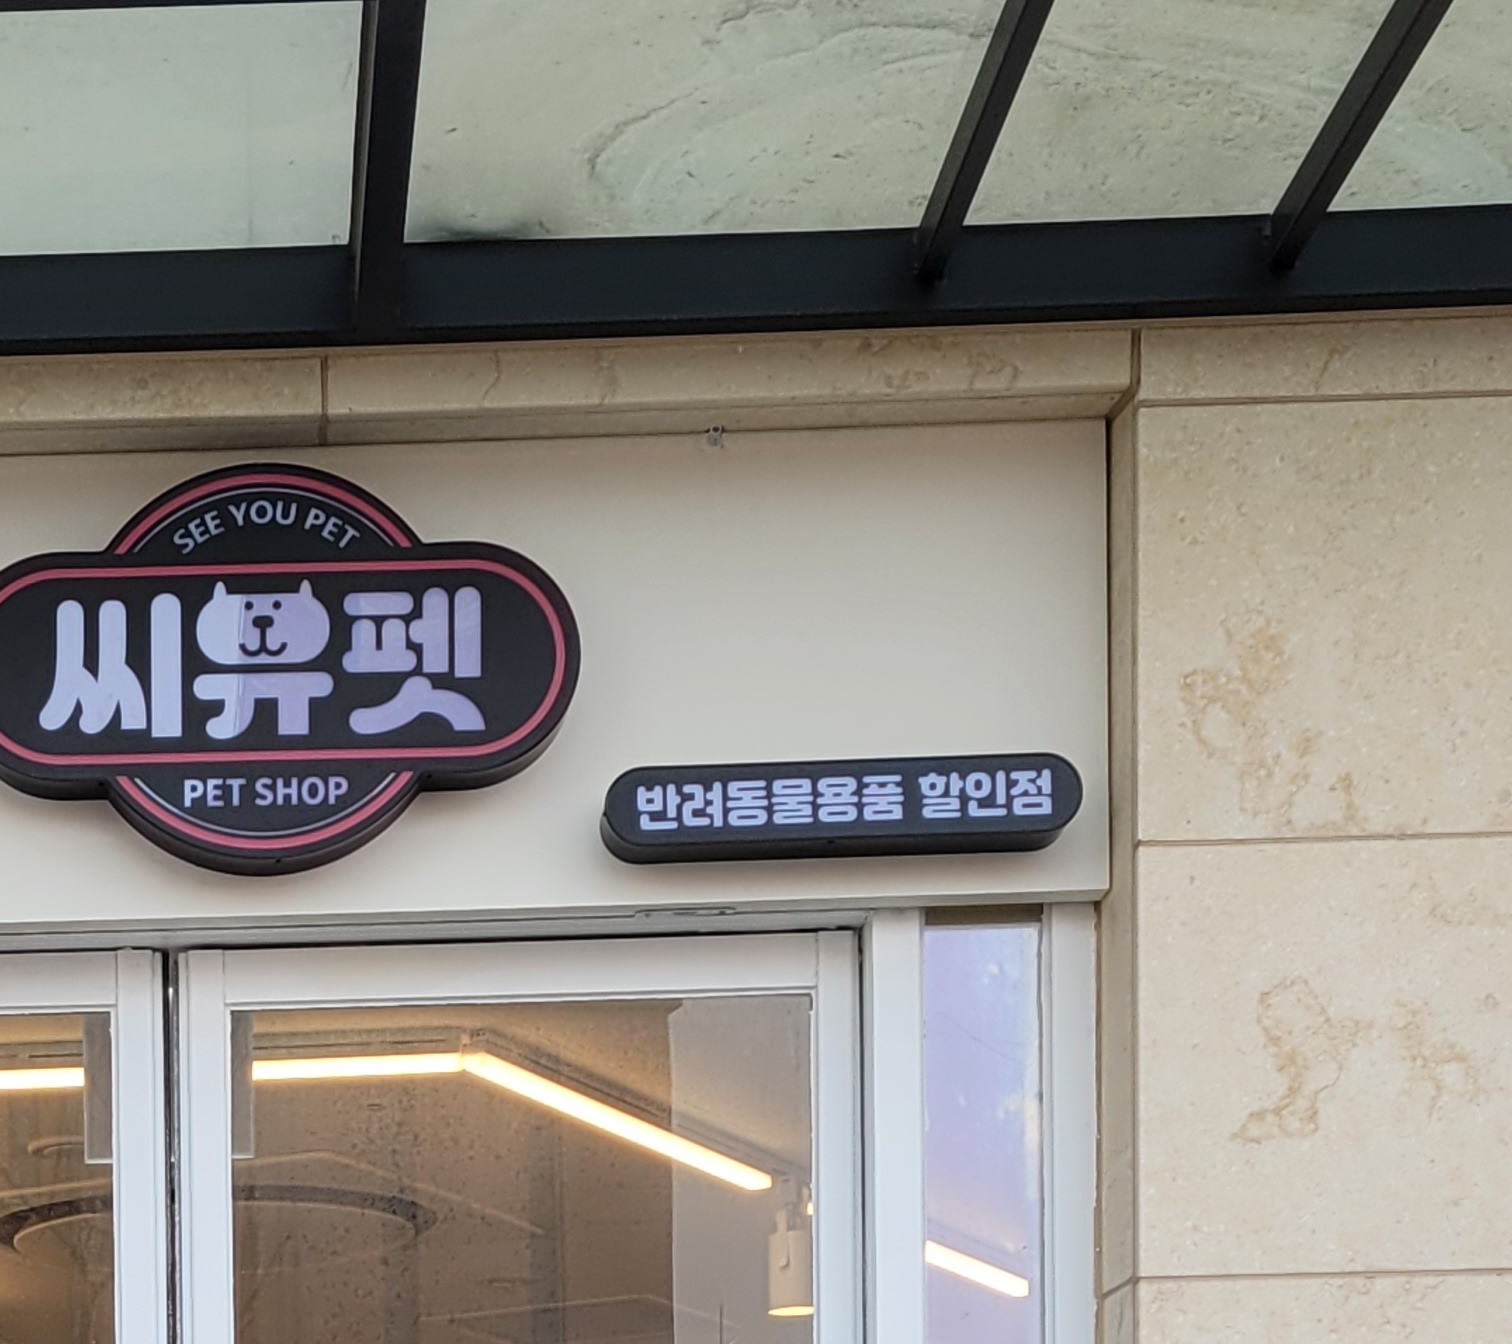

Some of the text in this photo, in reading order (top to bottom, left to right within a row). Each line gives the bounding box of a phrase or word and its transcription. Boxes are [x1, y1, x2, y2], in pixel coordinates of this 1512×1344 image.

[173, 500, 361, 554] SEE YOU PET
[39, 580, 485, 739] 씨유펫
[184, 774, 349, 808] PET SHOP
[637, 769, 1052, 830] 반려동물용품 할인점
